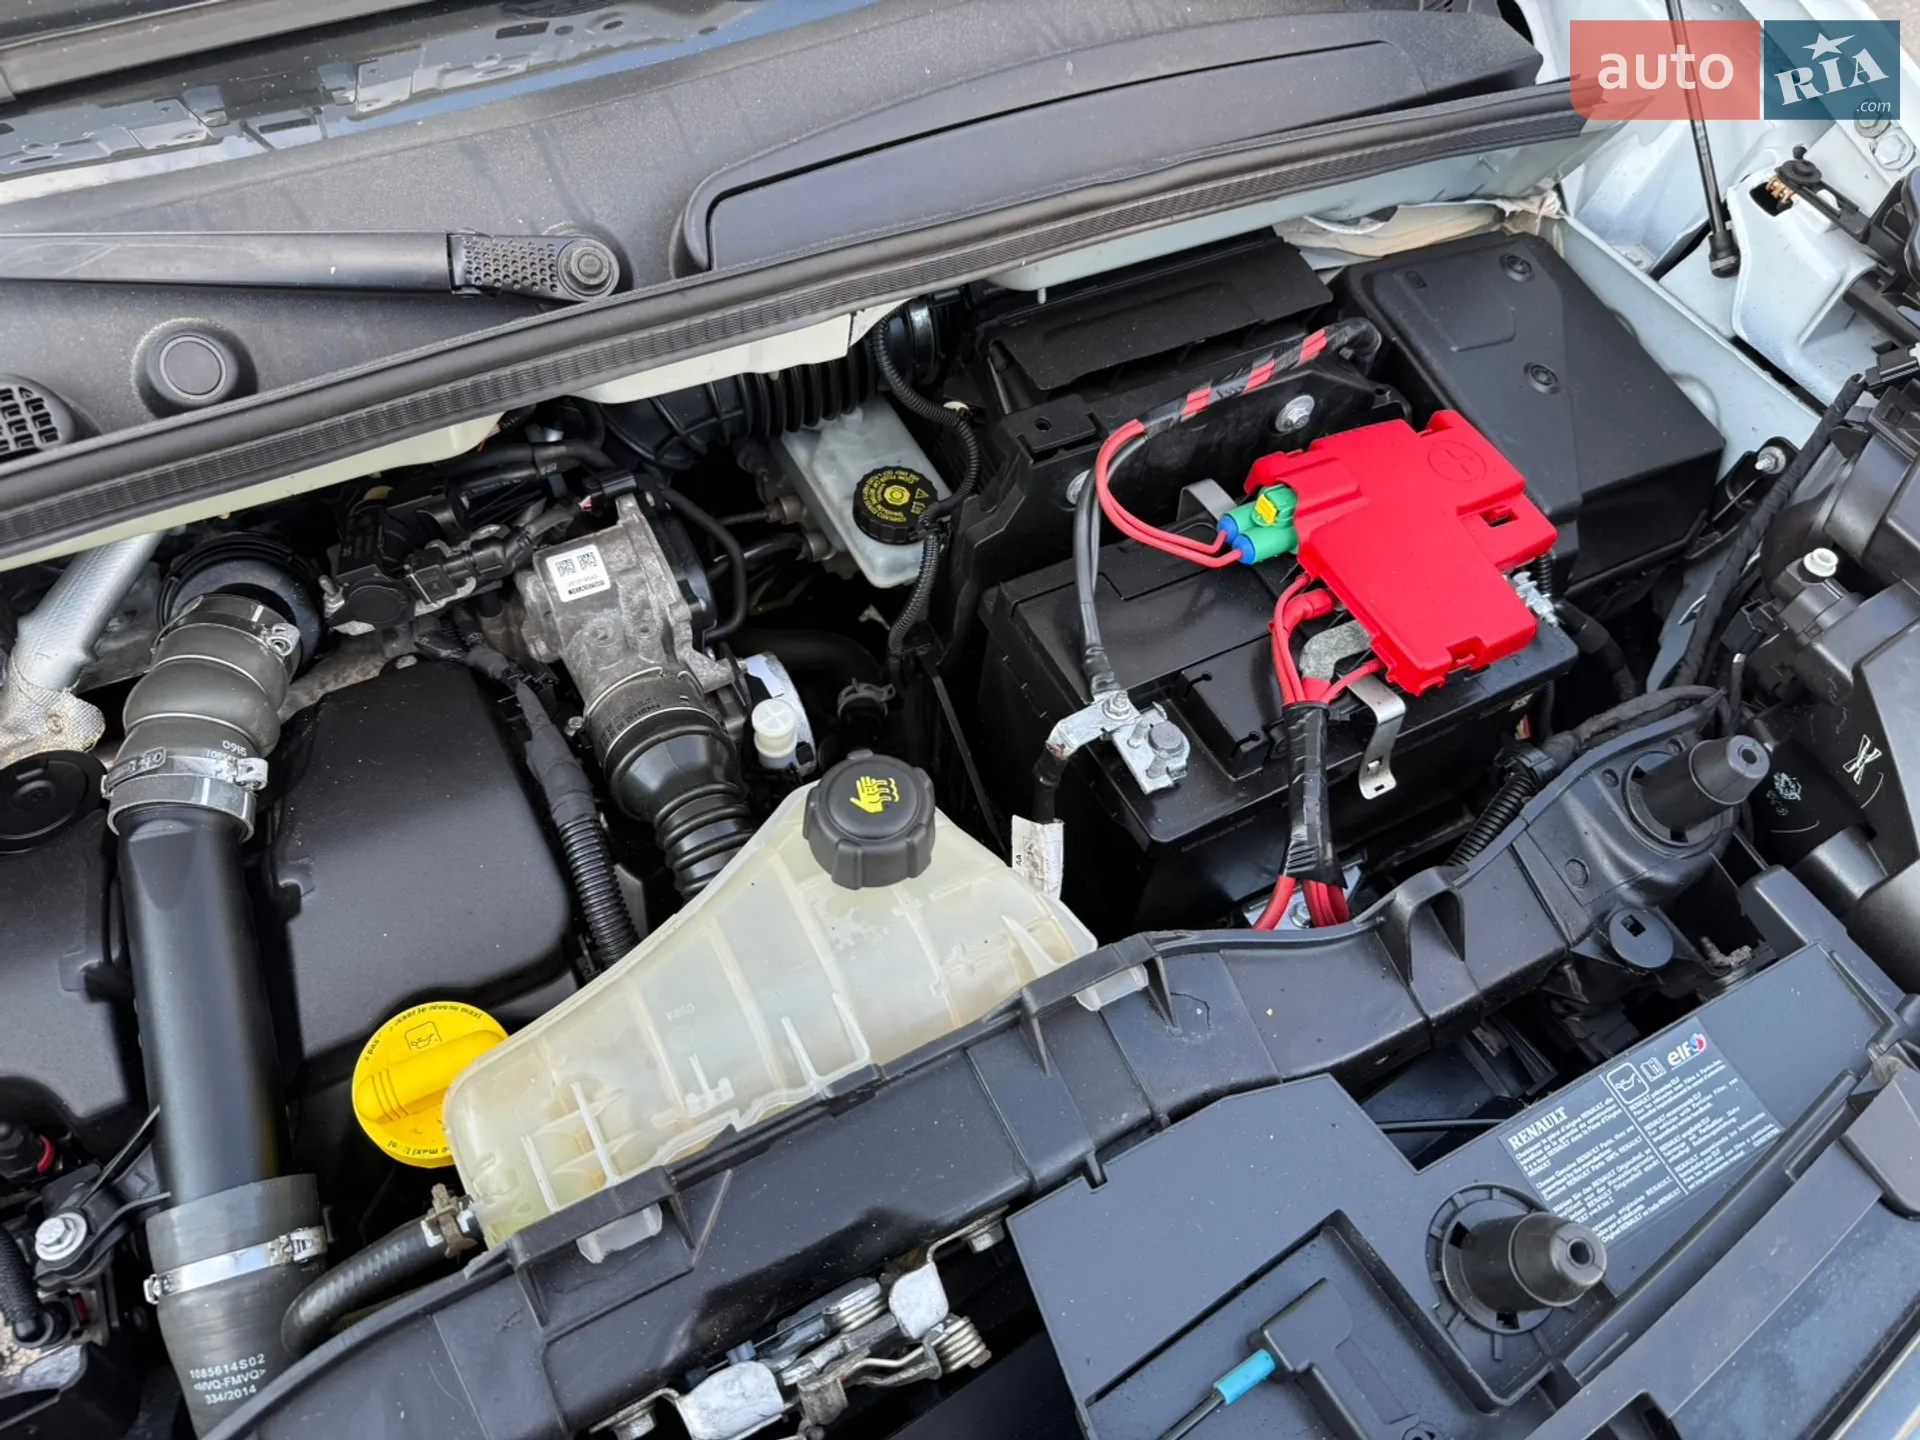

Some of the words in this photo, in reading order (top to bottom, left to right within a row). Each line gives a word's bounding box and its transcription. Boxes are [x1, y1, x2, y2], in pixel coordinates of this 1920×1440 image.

[460, 1007, 483, 1019] maxi
[1667, 1041, 1694, 1066] elf
[1508, 1106, 1567, 1150] RENAULT
